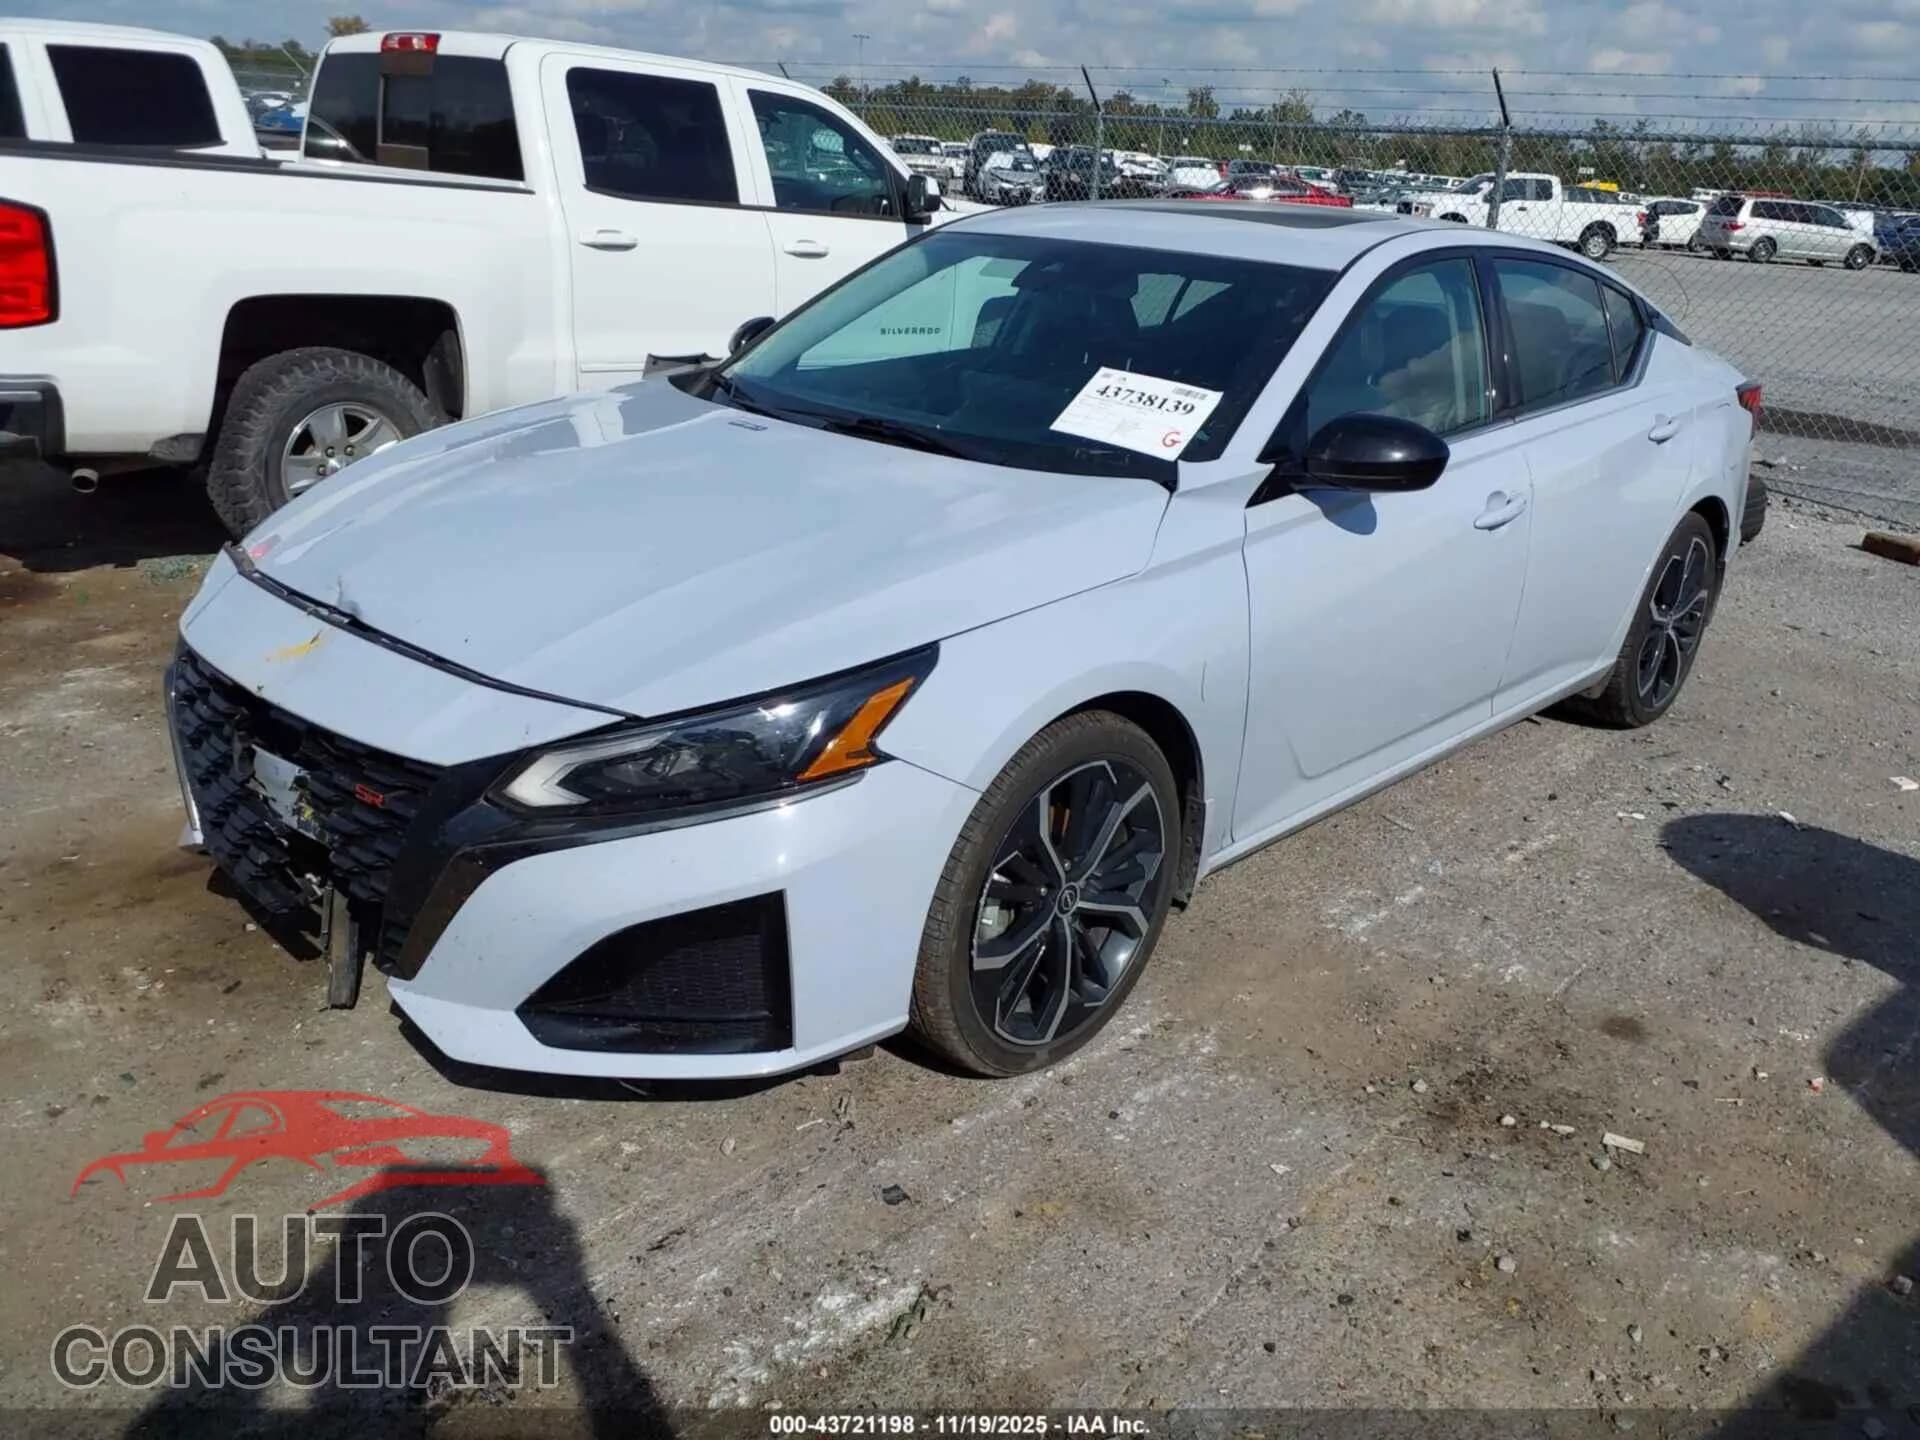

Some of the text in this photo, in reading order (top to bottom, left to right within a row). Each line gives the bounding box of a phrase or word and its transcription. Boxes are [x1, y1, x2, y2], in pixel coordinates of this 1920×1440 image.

[880, 326, 942, 336] SILVERADO
[1095, 384, 1196, 416] 43738139
[354, 783, 385, 809] SR
